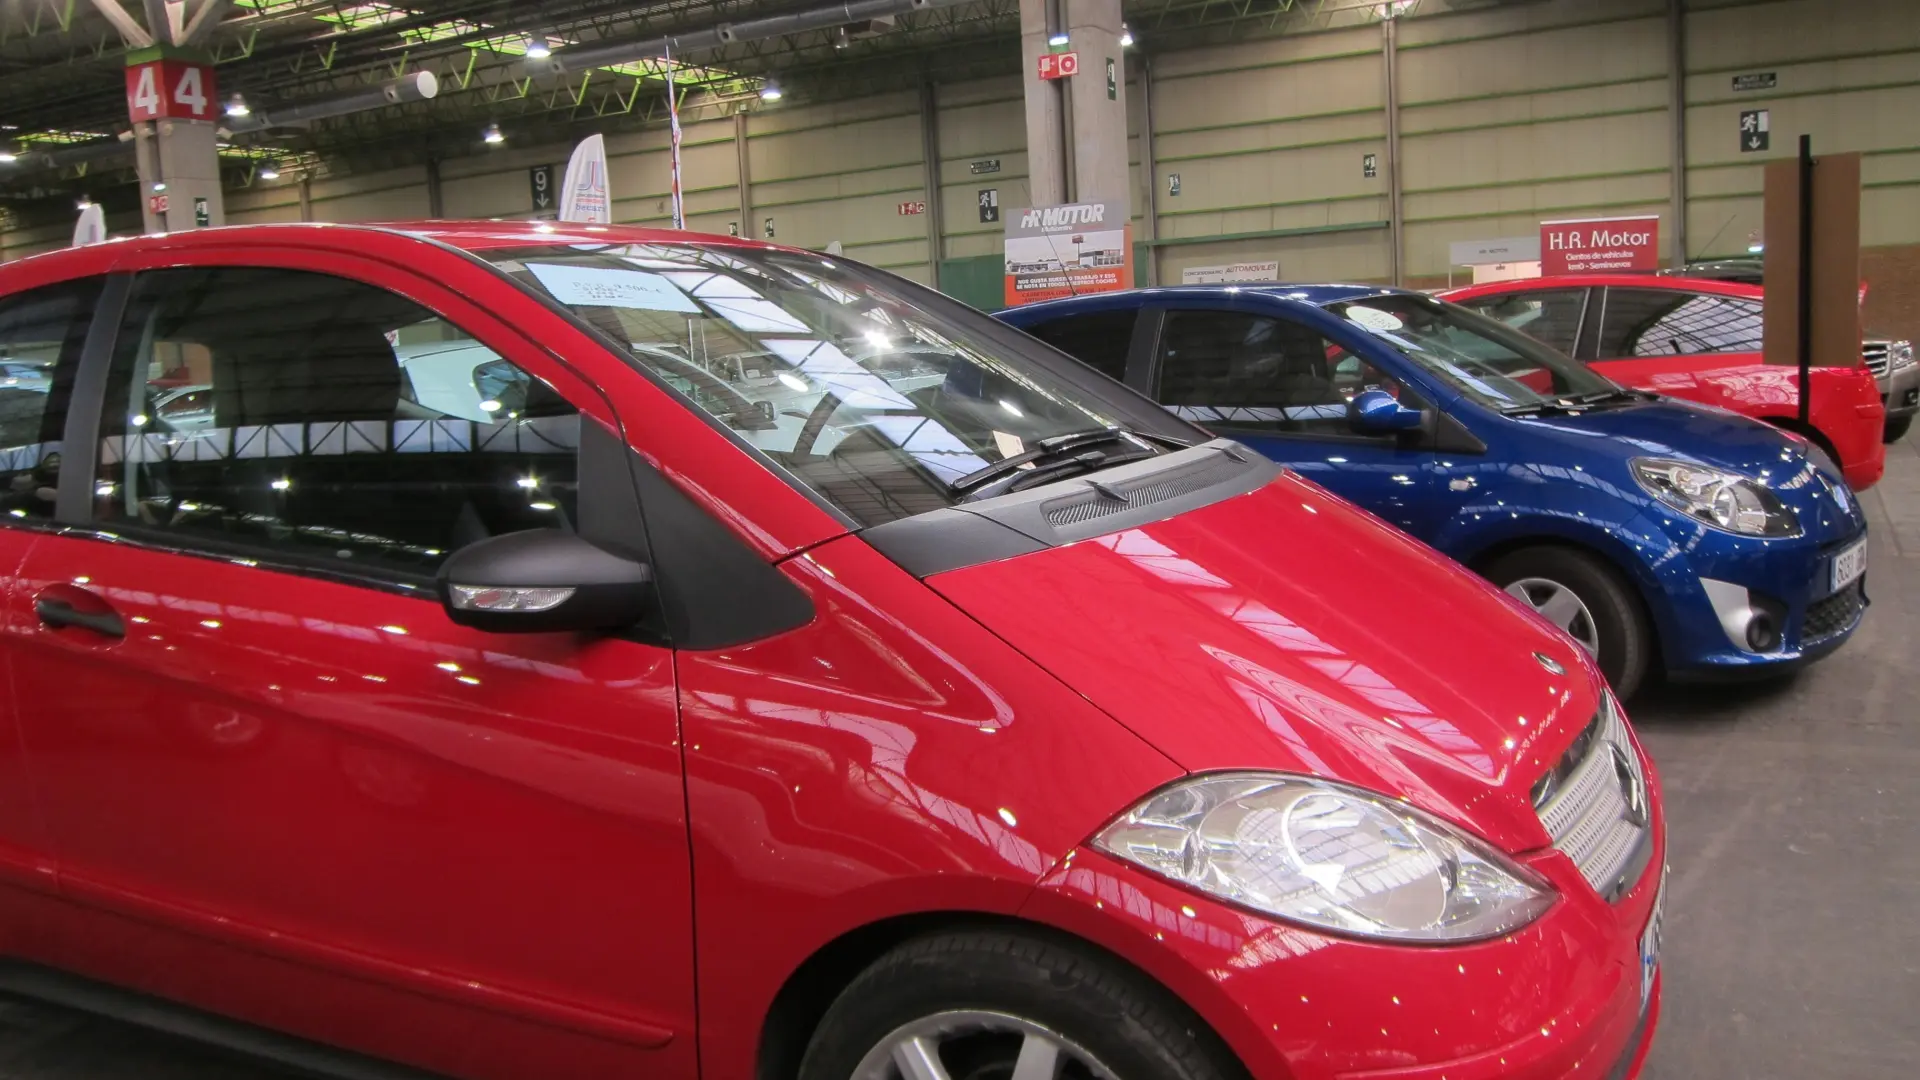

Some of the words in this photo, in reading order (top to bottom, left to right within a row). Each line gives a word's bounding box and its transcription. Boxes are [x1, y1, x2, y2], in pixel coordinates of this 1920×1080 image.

[135, 66, 159, 115] 4
[174, 67, 207, 115] 4
[535, 171, 547, 191] 9
[1043, 204, 1104, 226] MOTOR
[1549, 231, 1586, 250] H.R.
[1590, 230, 1650, 248] Motor
[1566, 253, 1591, 261] Cientos
[1592, 252, 1602, 260] de
[1590, 261, 1632, 270] Seminuevos
[1225, 263, 1277, 274] AUTOMOVILES
